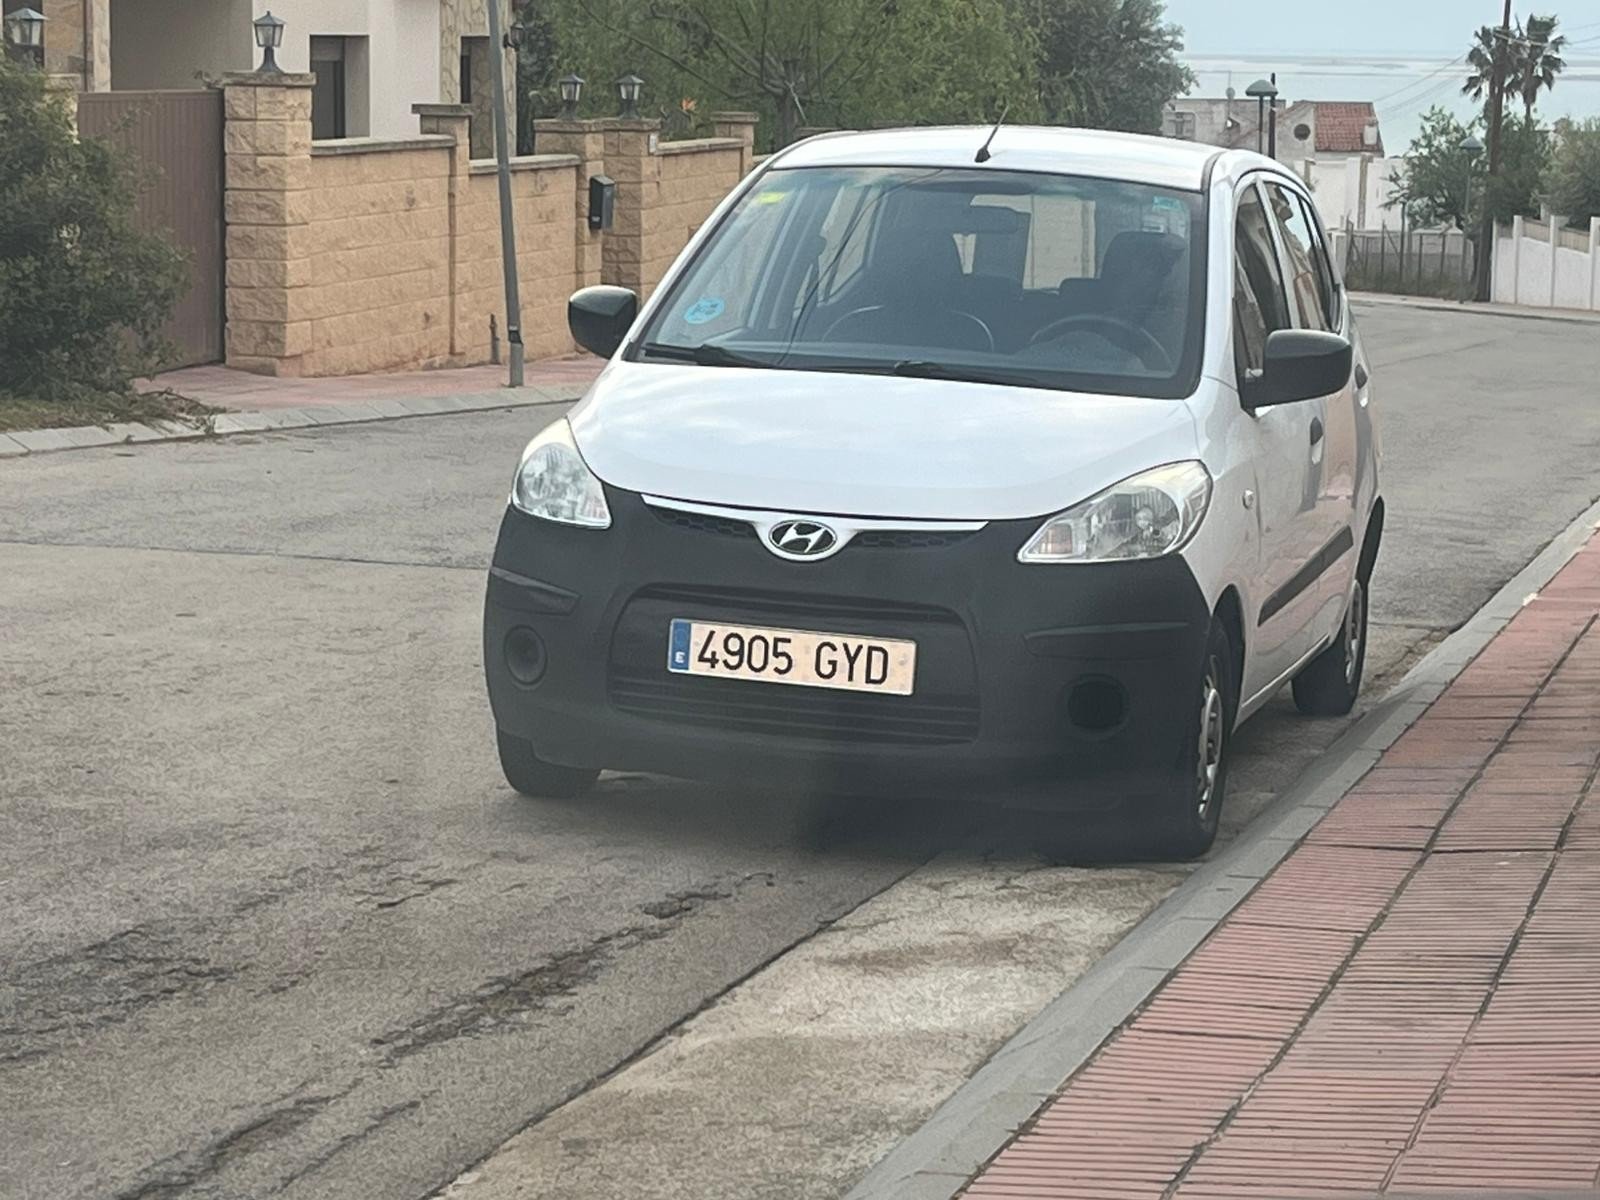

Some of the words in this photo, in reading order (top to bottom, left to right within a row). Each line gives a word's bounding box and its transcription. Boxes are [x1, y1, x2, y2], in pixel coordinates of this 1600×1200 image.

[674, 651, 685, 664] E
[697, 630, 793, 675] 4905
[814, 641, 889, 685] GYD
